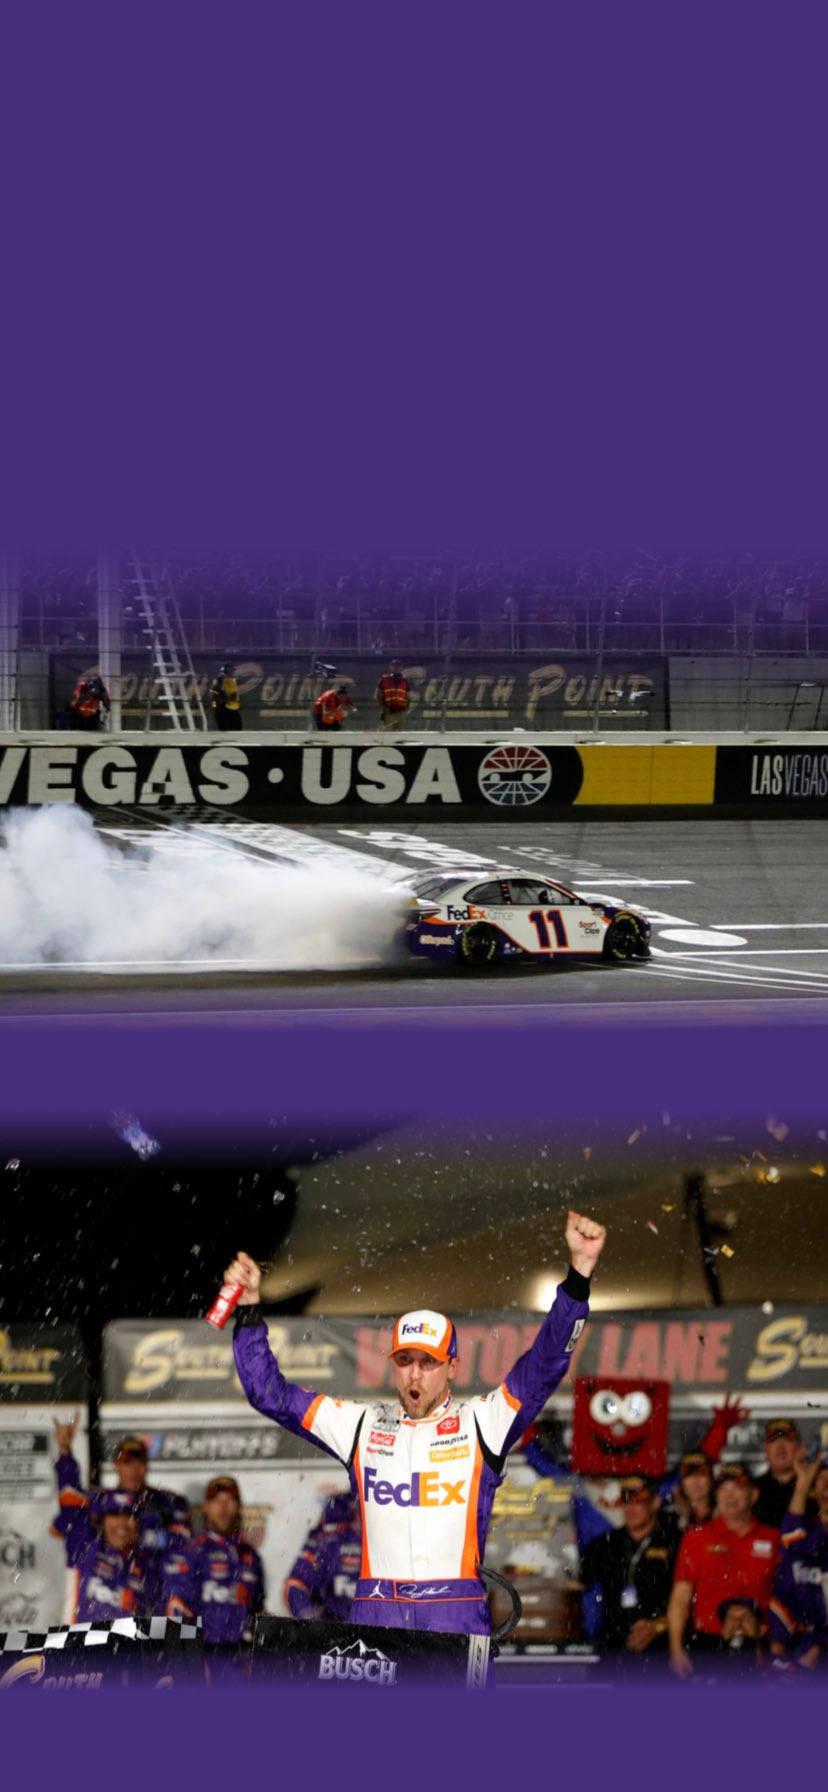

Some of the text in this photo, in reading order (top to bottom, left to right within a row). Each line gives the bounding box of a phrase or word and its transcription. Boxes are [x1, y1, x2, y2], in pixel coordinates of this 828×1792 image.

[524, 664, 653, 721] POINT
[301, 747, 462, 805] USA
[447, 905, 487, 921] FedEx
[528, 910, 569, 949] 11
[402, 1323, 436, 1338] FedEx
[600, 1320, 733, 1382] LANE
[364, 1466, 466, 1508] FedEx
[318, 1654, 397, 1687] BUSCH
